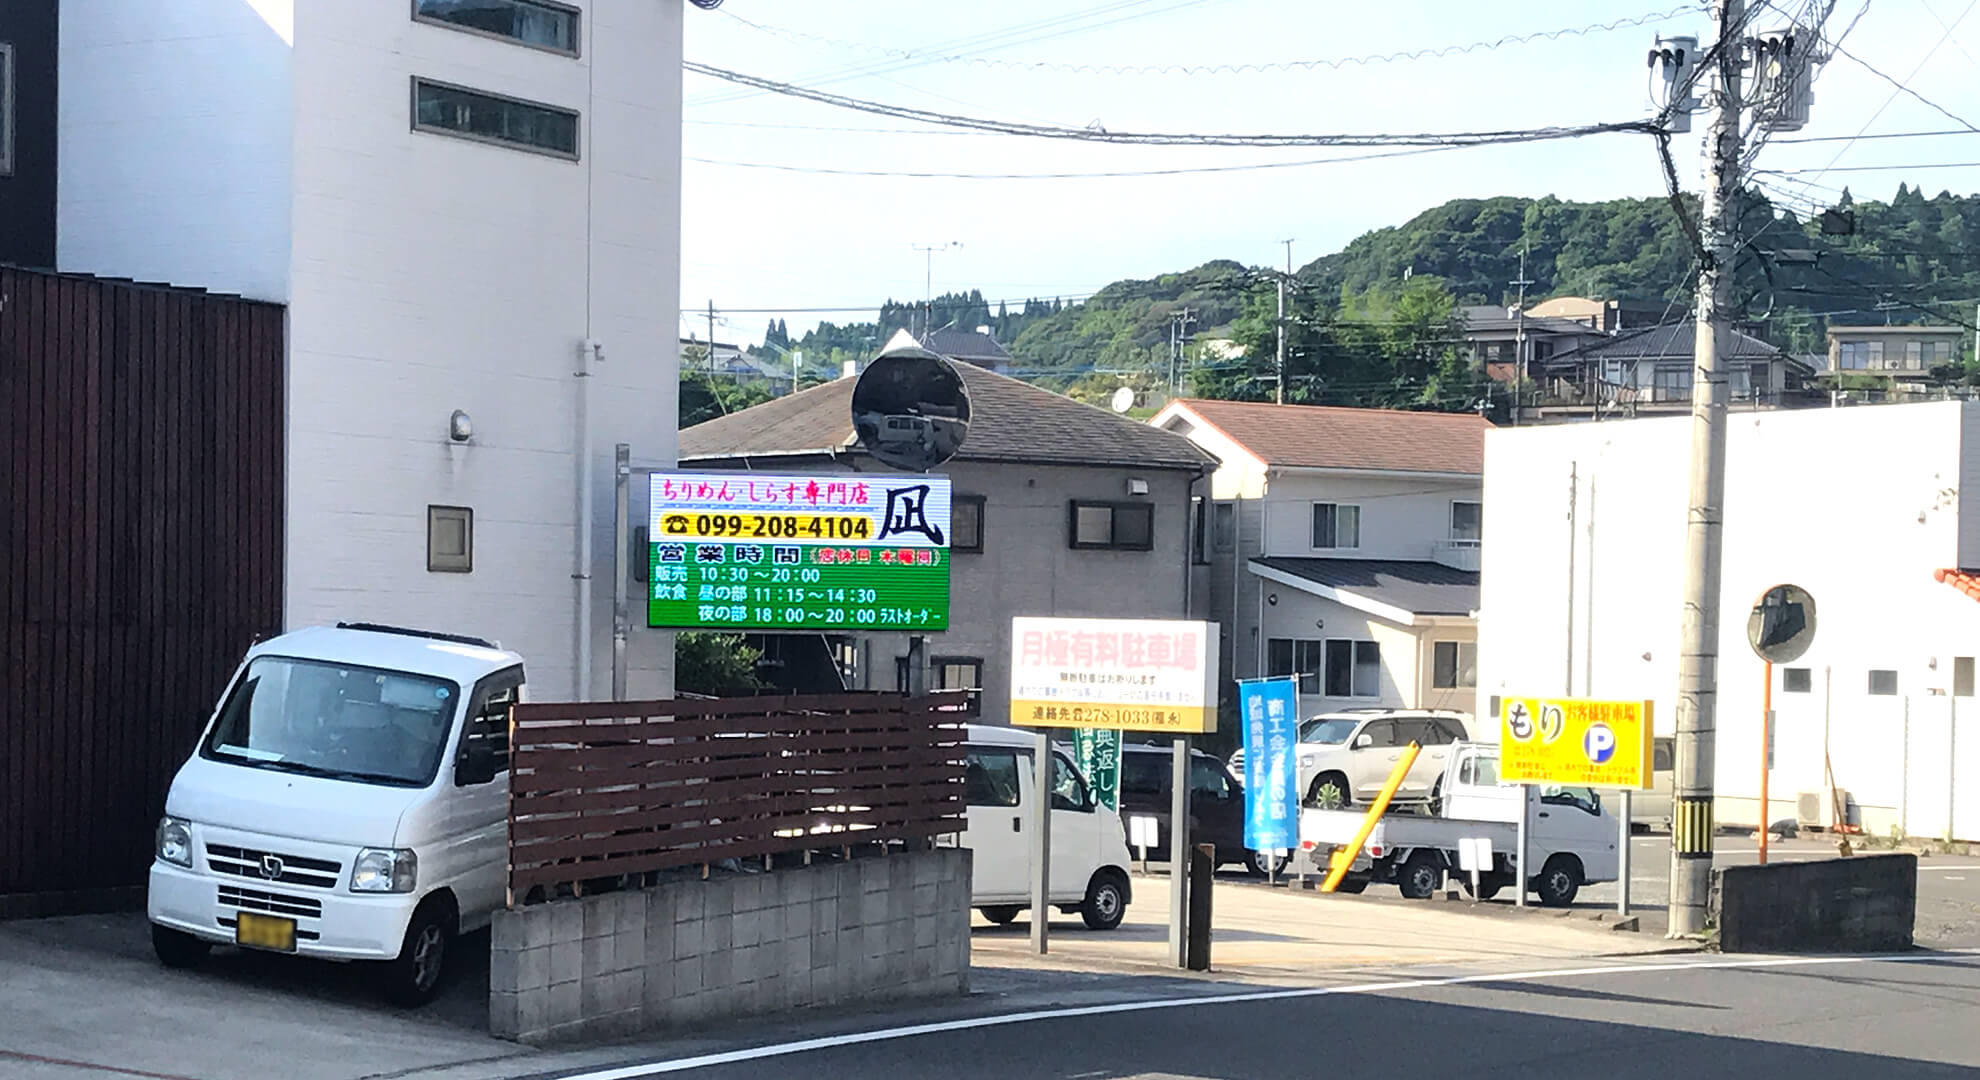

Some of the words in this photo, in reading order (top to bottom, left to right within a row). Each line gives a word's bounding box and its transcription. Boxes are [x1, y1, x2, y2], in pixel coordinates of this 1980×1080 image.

[877, 484, 945, 546] 凪
[696, 515, 868, 538] 099-208-4104
[658, 544, 801, 564] 営業時間
[654, 566, 688, 582] 販売
[654, 584, 688, 600] 飲食
[698, 585, 748, 602] 昼の部
[698, 605, 748, 622] 夜の部
[1021, 630, 1197, 671] 月極有料駐車場
[1032, 705, 1071, 721] 連絡先
[1510, 703, 1562, 740] もり
[1566, 703, 1636, 723] お客様駐車場
